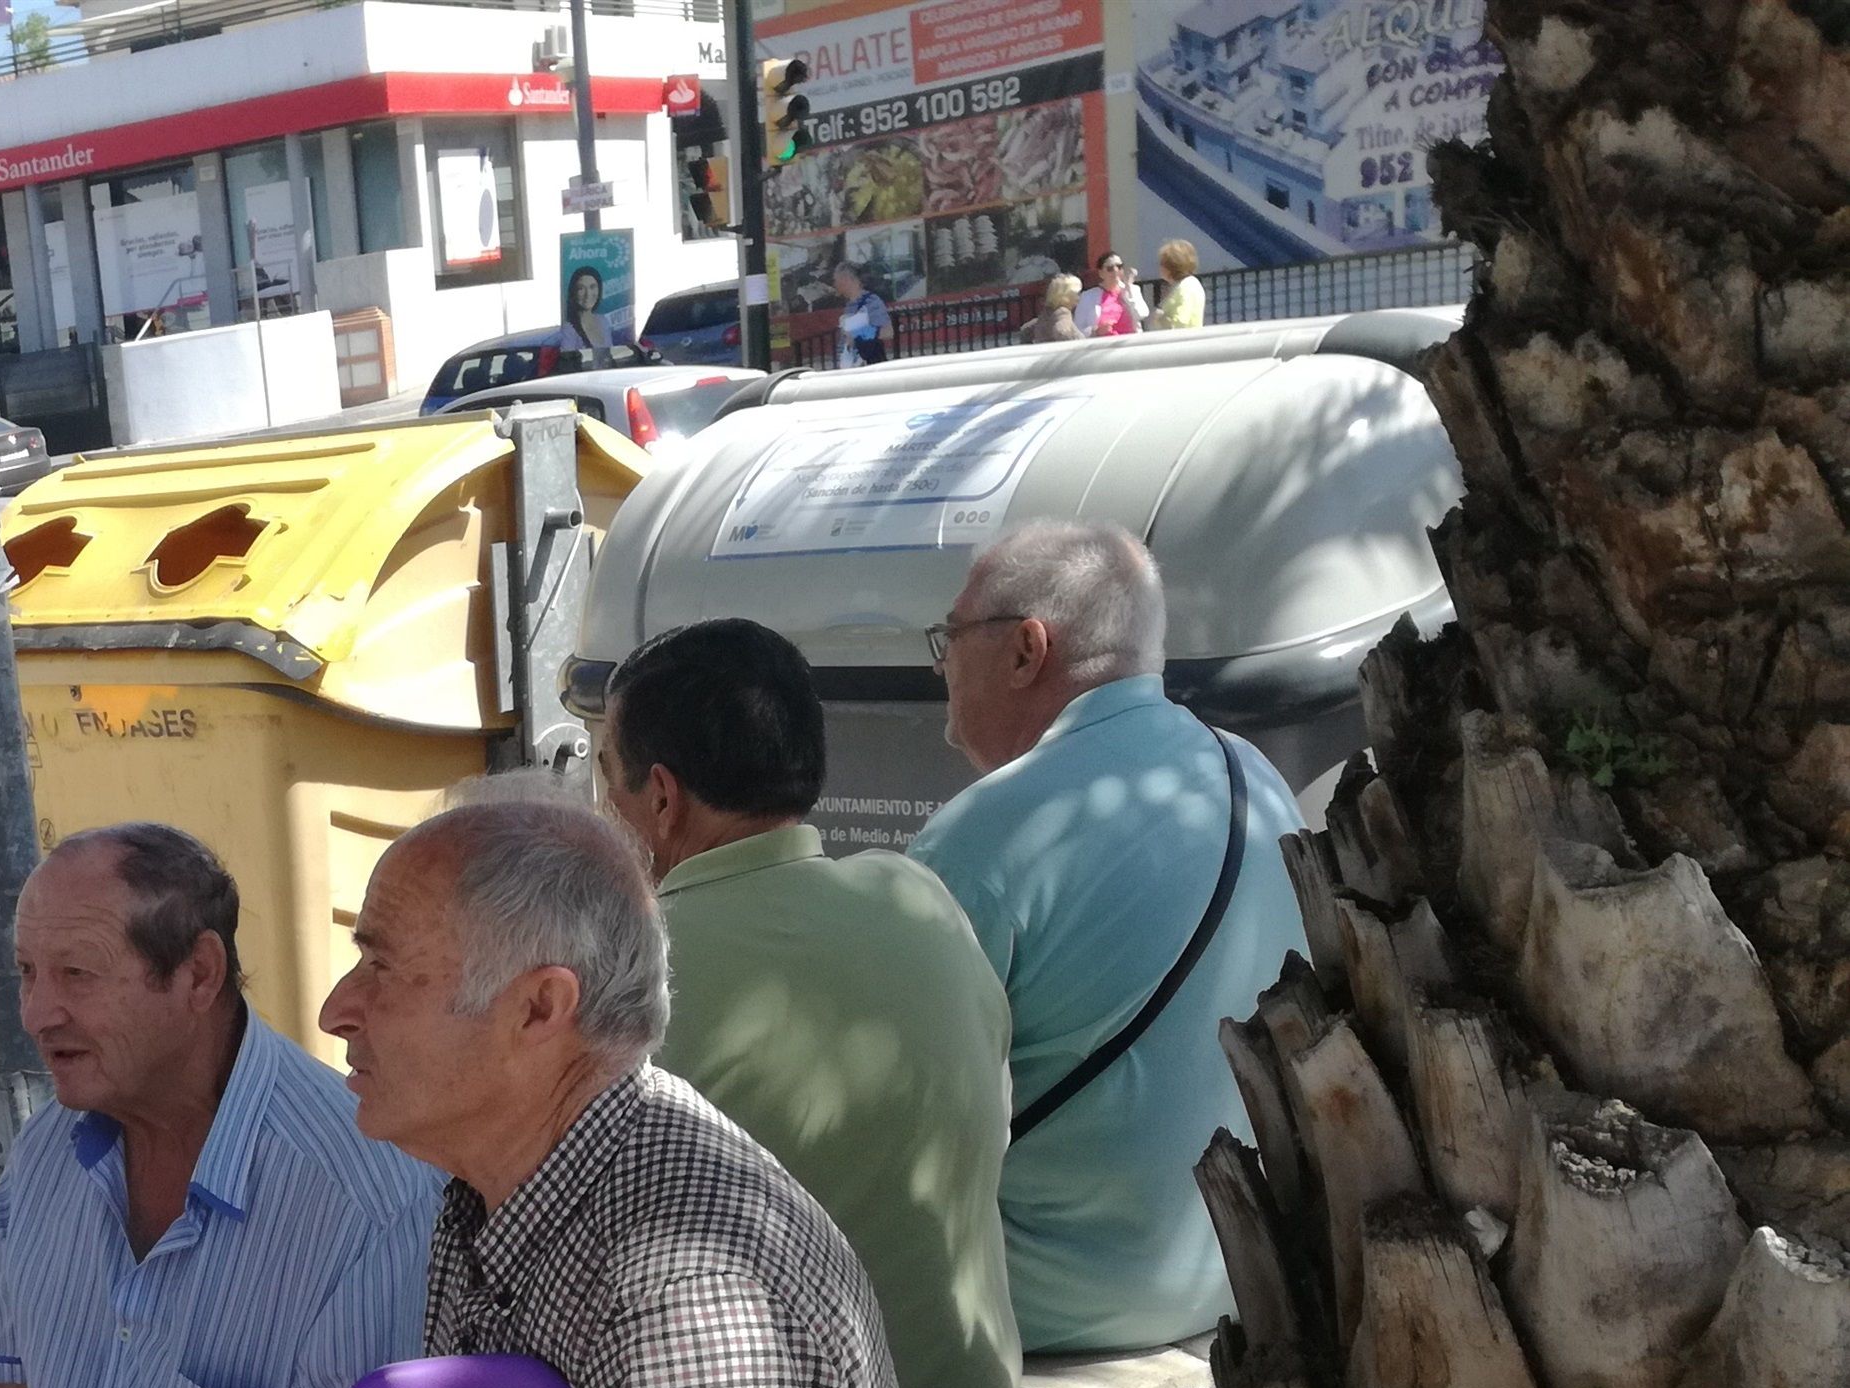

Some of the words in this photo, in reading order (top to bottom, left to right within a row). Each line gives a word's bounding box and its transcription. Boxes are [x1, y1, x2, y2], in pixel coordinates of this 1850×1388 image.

[1324, 0, 1482, 50] ALQUI
[860, 105, 909, 135] 952
[915, 88, 966, 123] 100
[970, 76, 1022, 113] 592
[1359, 151, 1414, 188] 952
[568, 246, 608, 261] Ahora
[811, 796, 912, 817] AYUNTAMIENTO
[915, 801, 934, 817] DE
[830, 826, 847, 842] de
[850, 827, 891, 844] Medio
